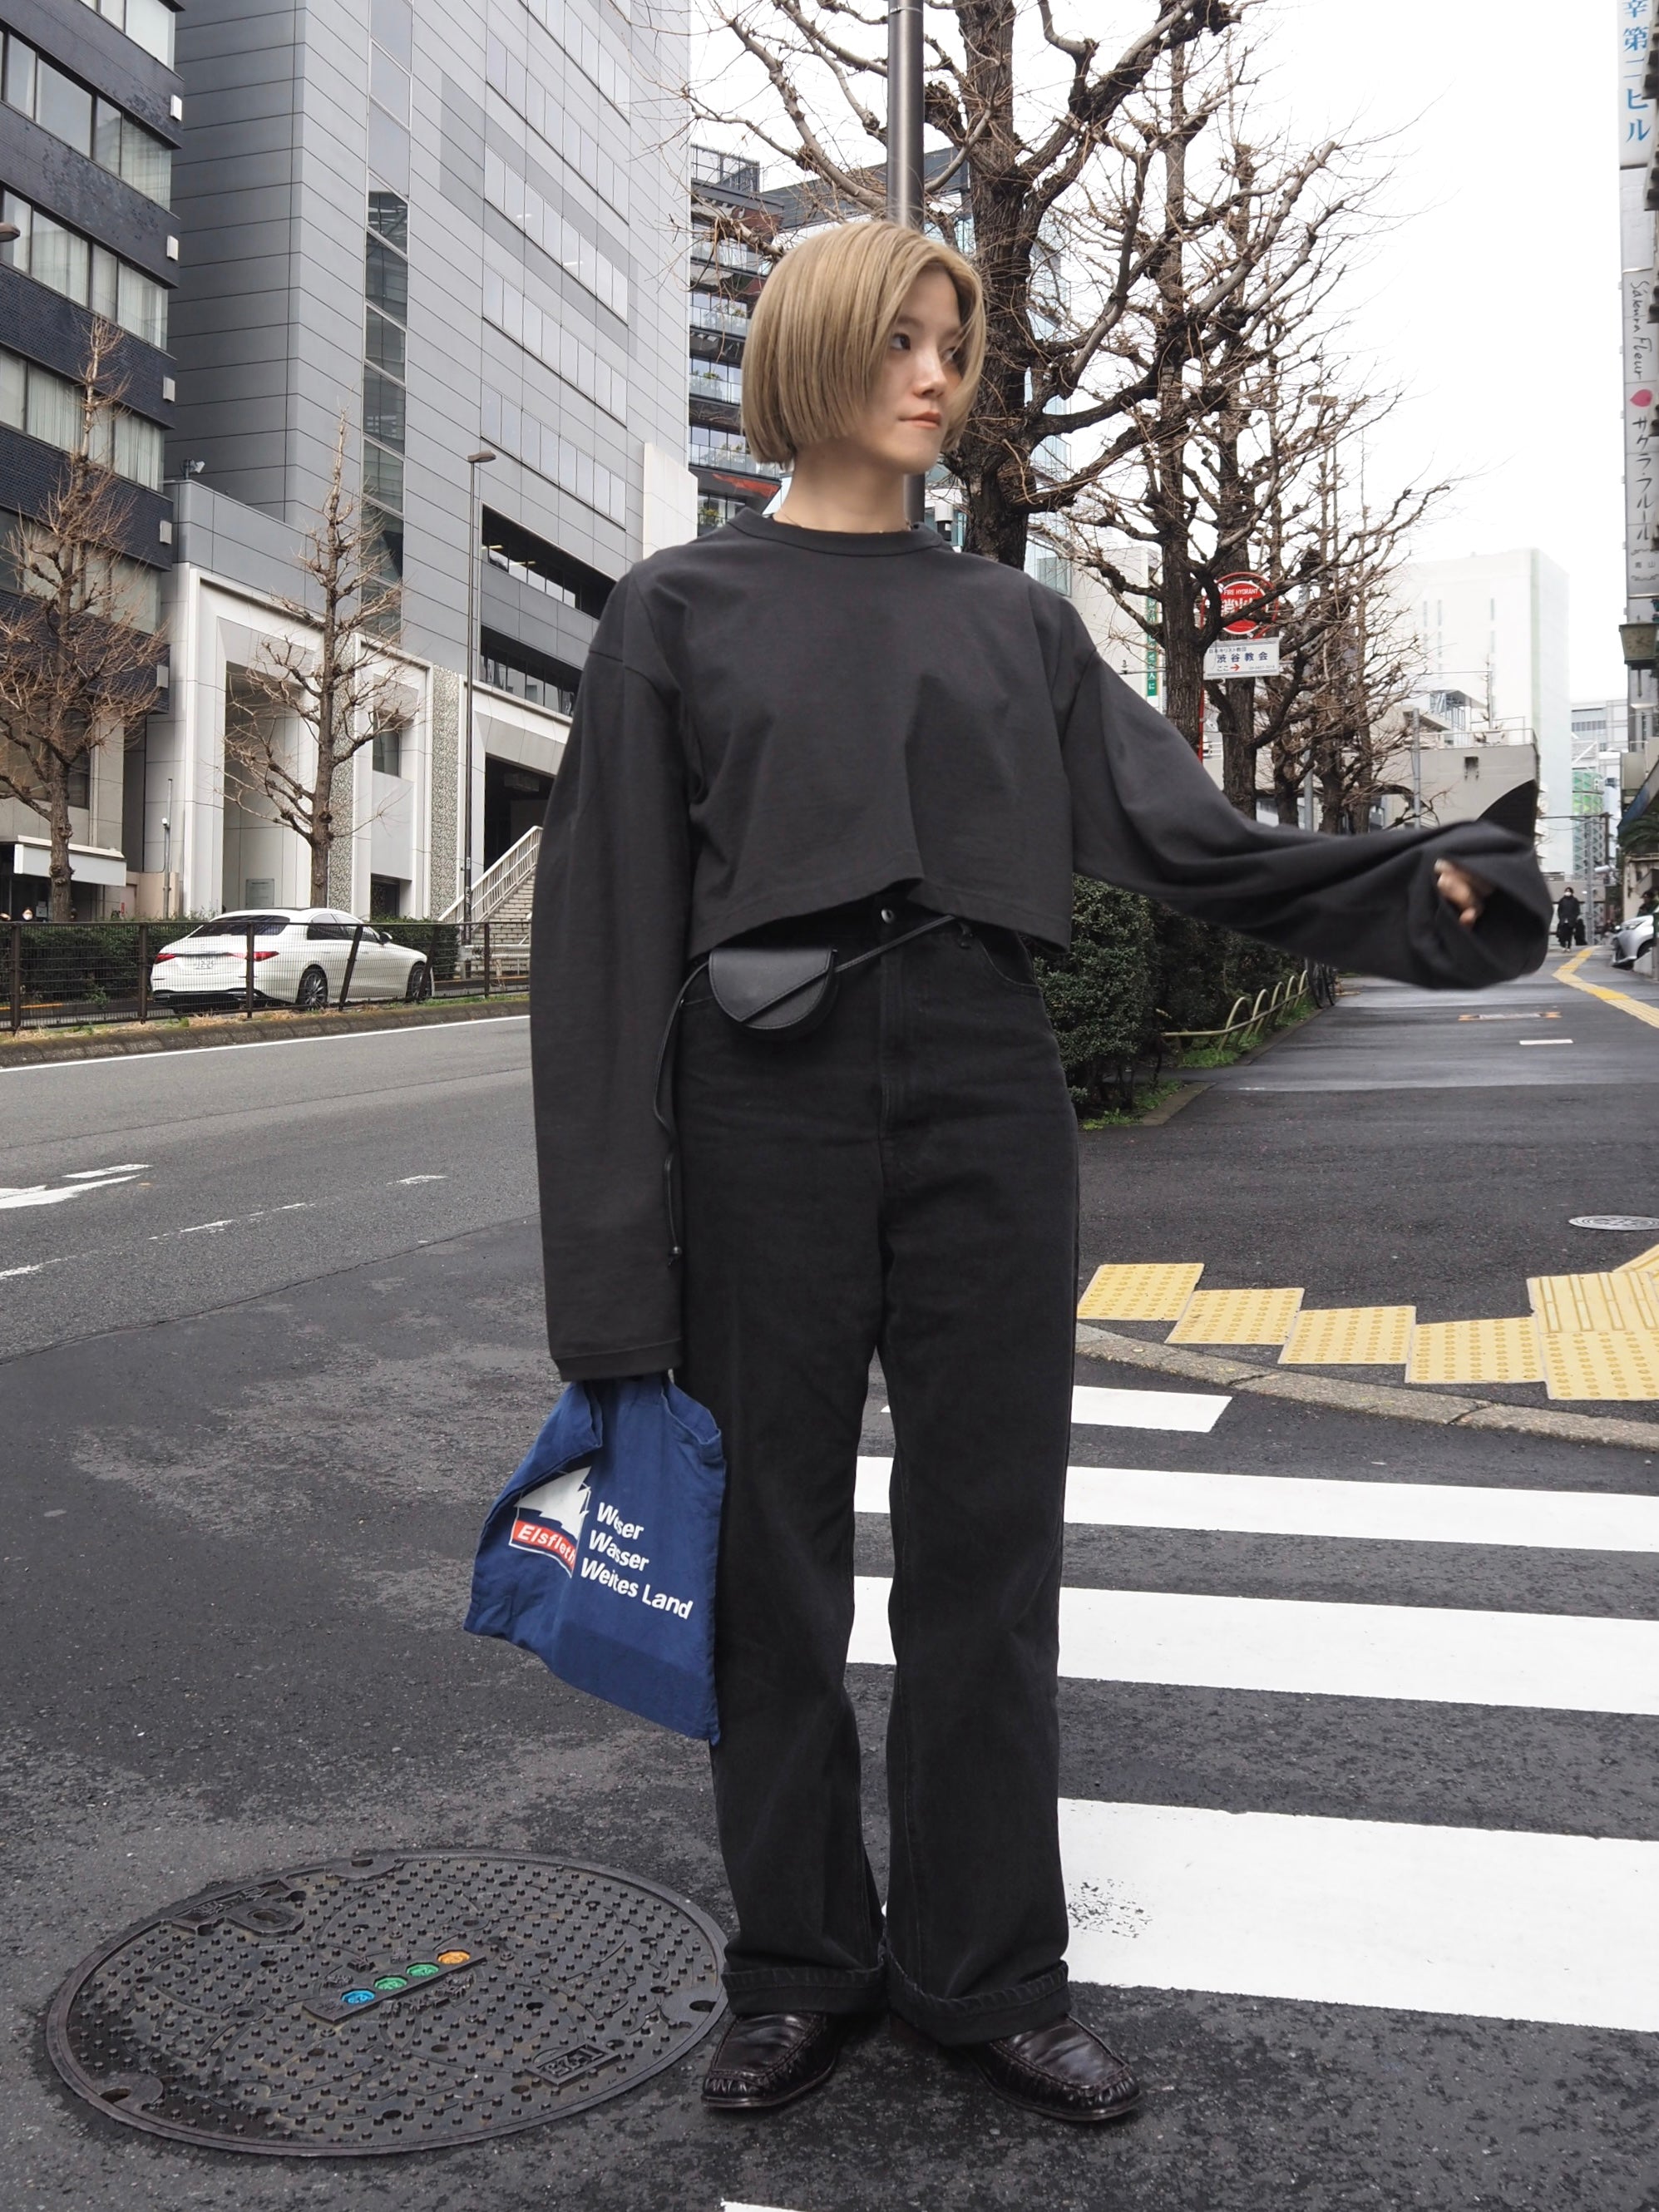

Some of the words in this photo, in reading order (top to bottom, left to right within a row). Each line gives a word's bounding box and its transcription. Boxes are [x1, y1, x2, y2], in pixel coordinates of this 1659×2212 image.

[1632, 336, 1652, 380] Fleur
[1217, 652, 1268, 664] 渋谷教会
[517, 1524, 575, 1565] Elsfleth
[589, 1529, 649, 1572] Wasser
[580, 1557, 639, 1597] Weites
[641, 1583, 694, 1620] Land
